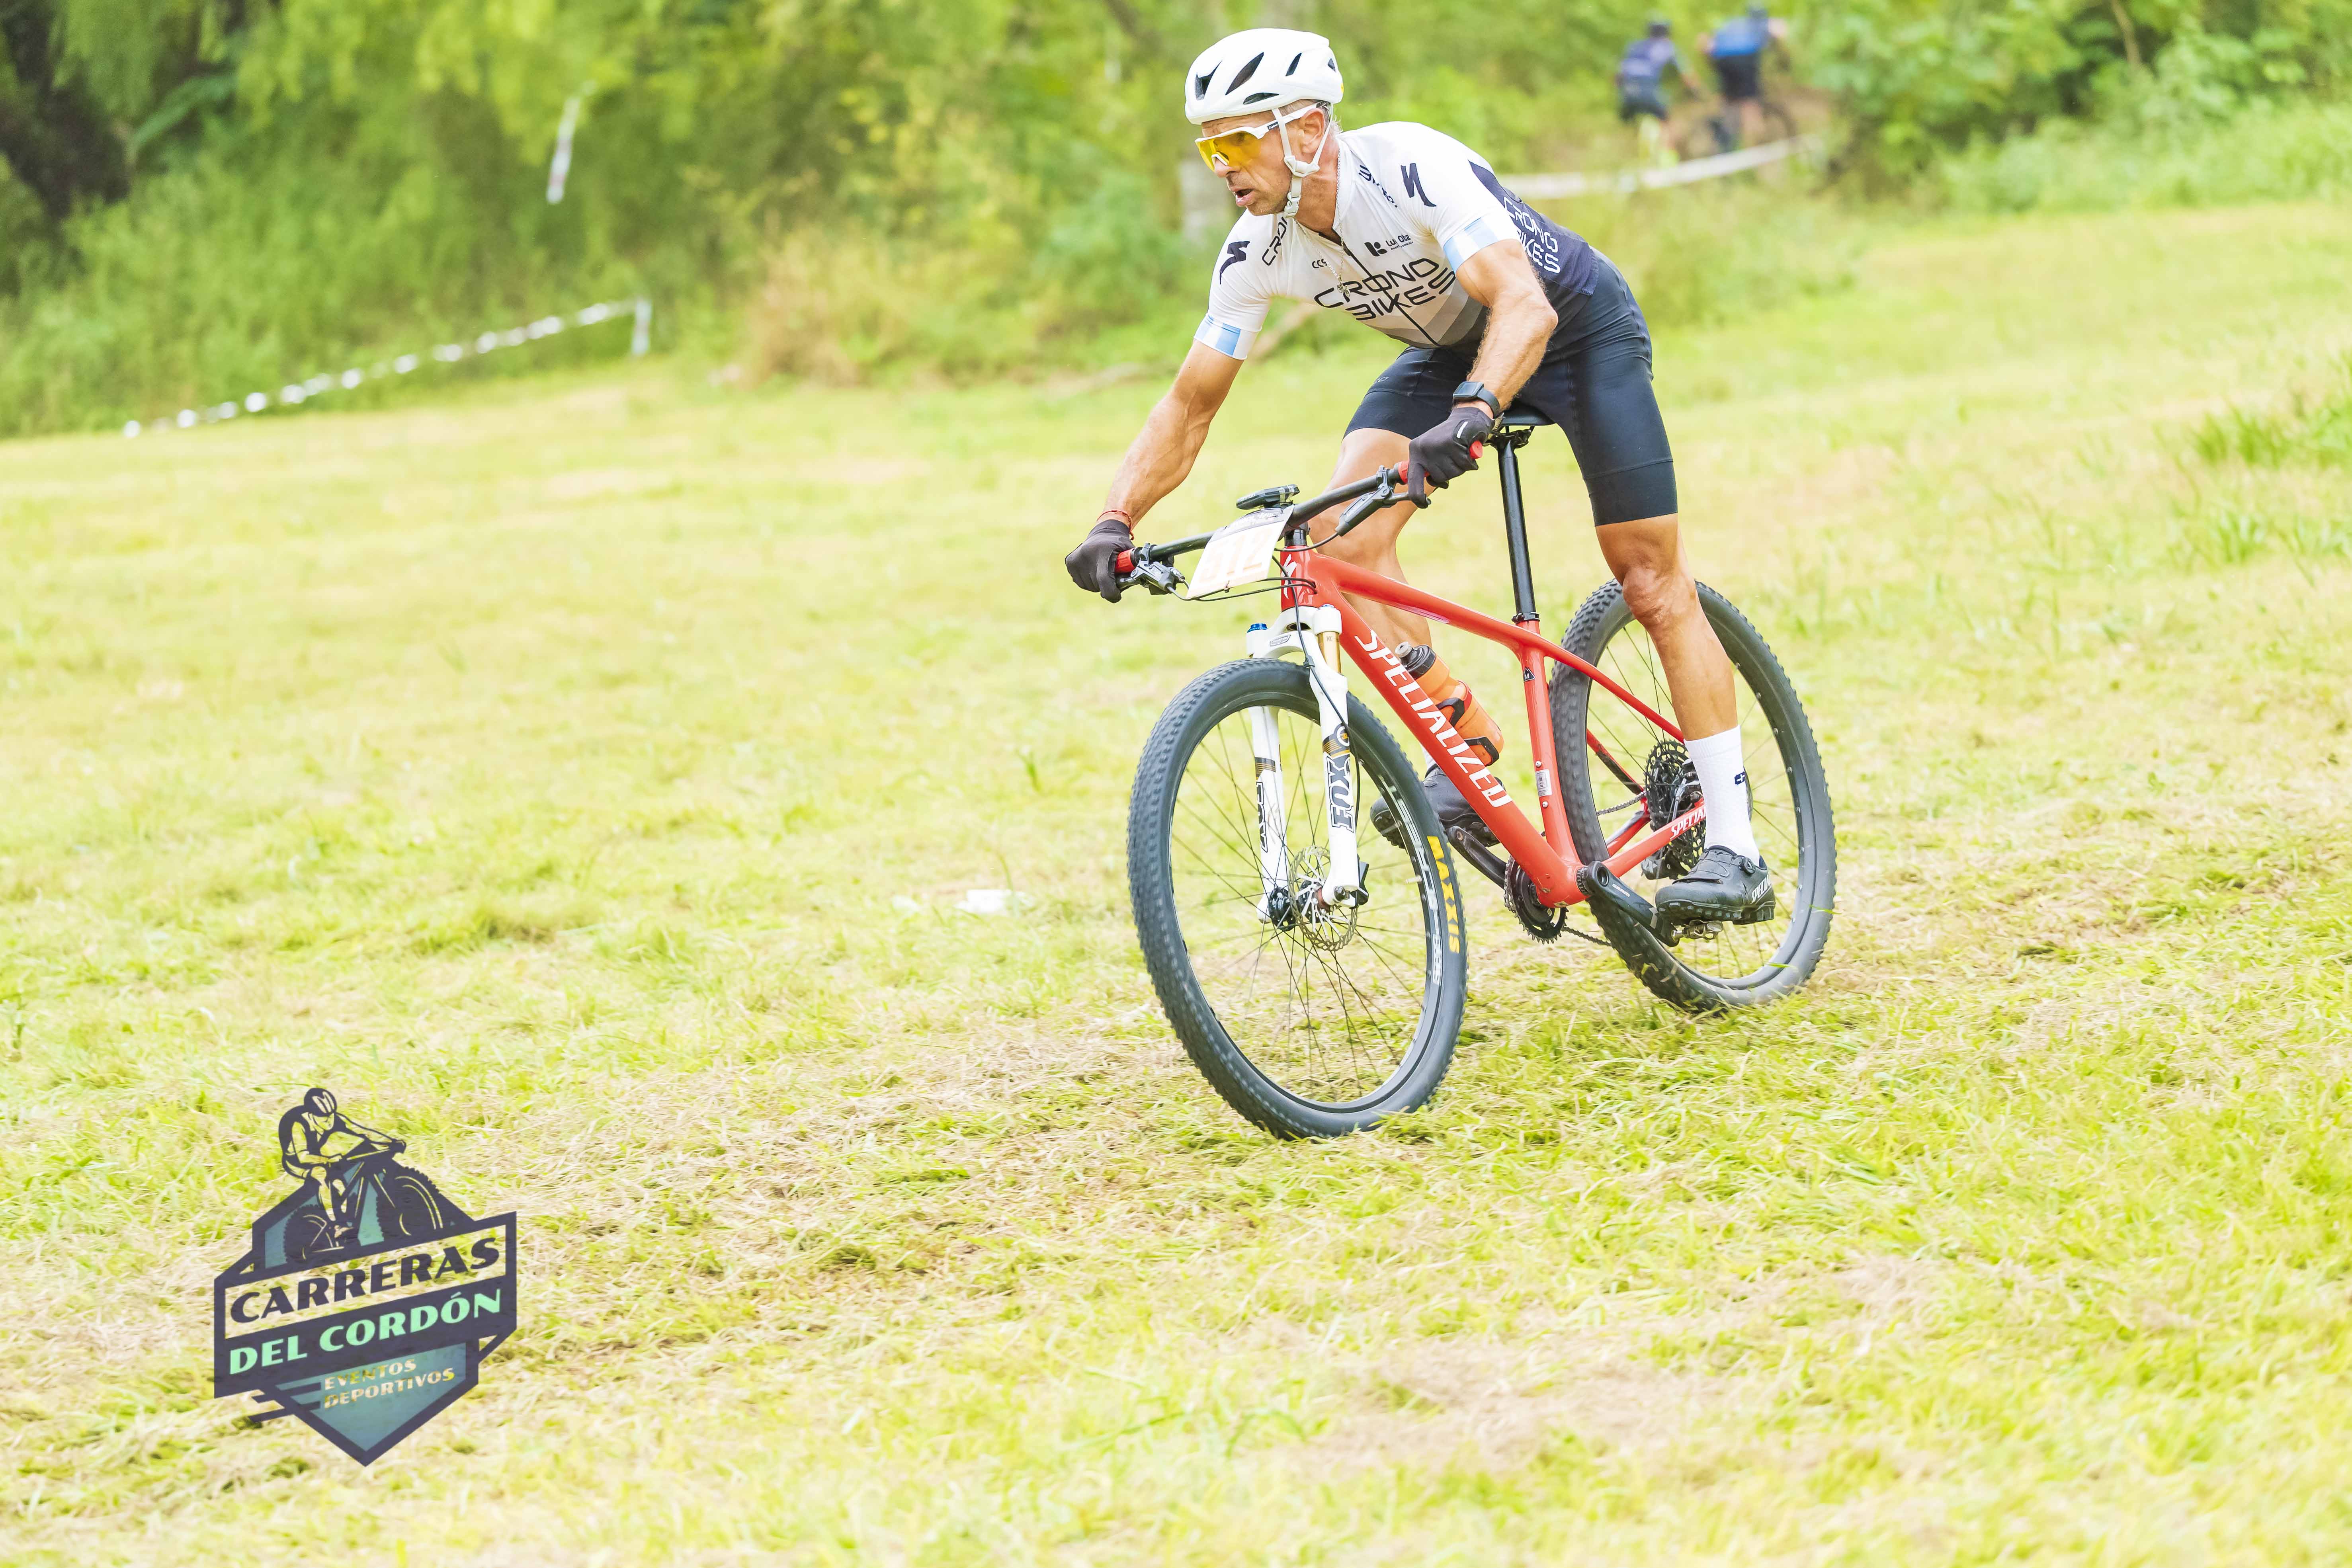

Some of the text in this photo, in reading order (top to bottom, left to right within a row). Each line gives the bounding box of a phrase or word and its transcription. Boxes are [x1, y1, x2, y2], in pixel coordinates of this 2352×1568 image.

[1503, 196, 1558, 253] CRONO
[1314, 258, 1440, 309] CRONO
[1345, 267, 1456, 321] BIKES
[1354, 629, 1513, 808] SPECIALIZED
[1326, 756, 1354, 834] FOX
[1427, 835, 1461, 954] MAXXIS
